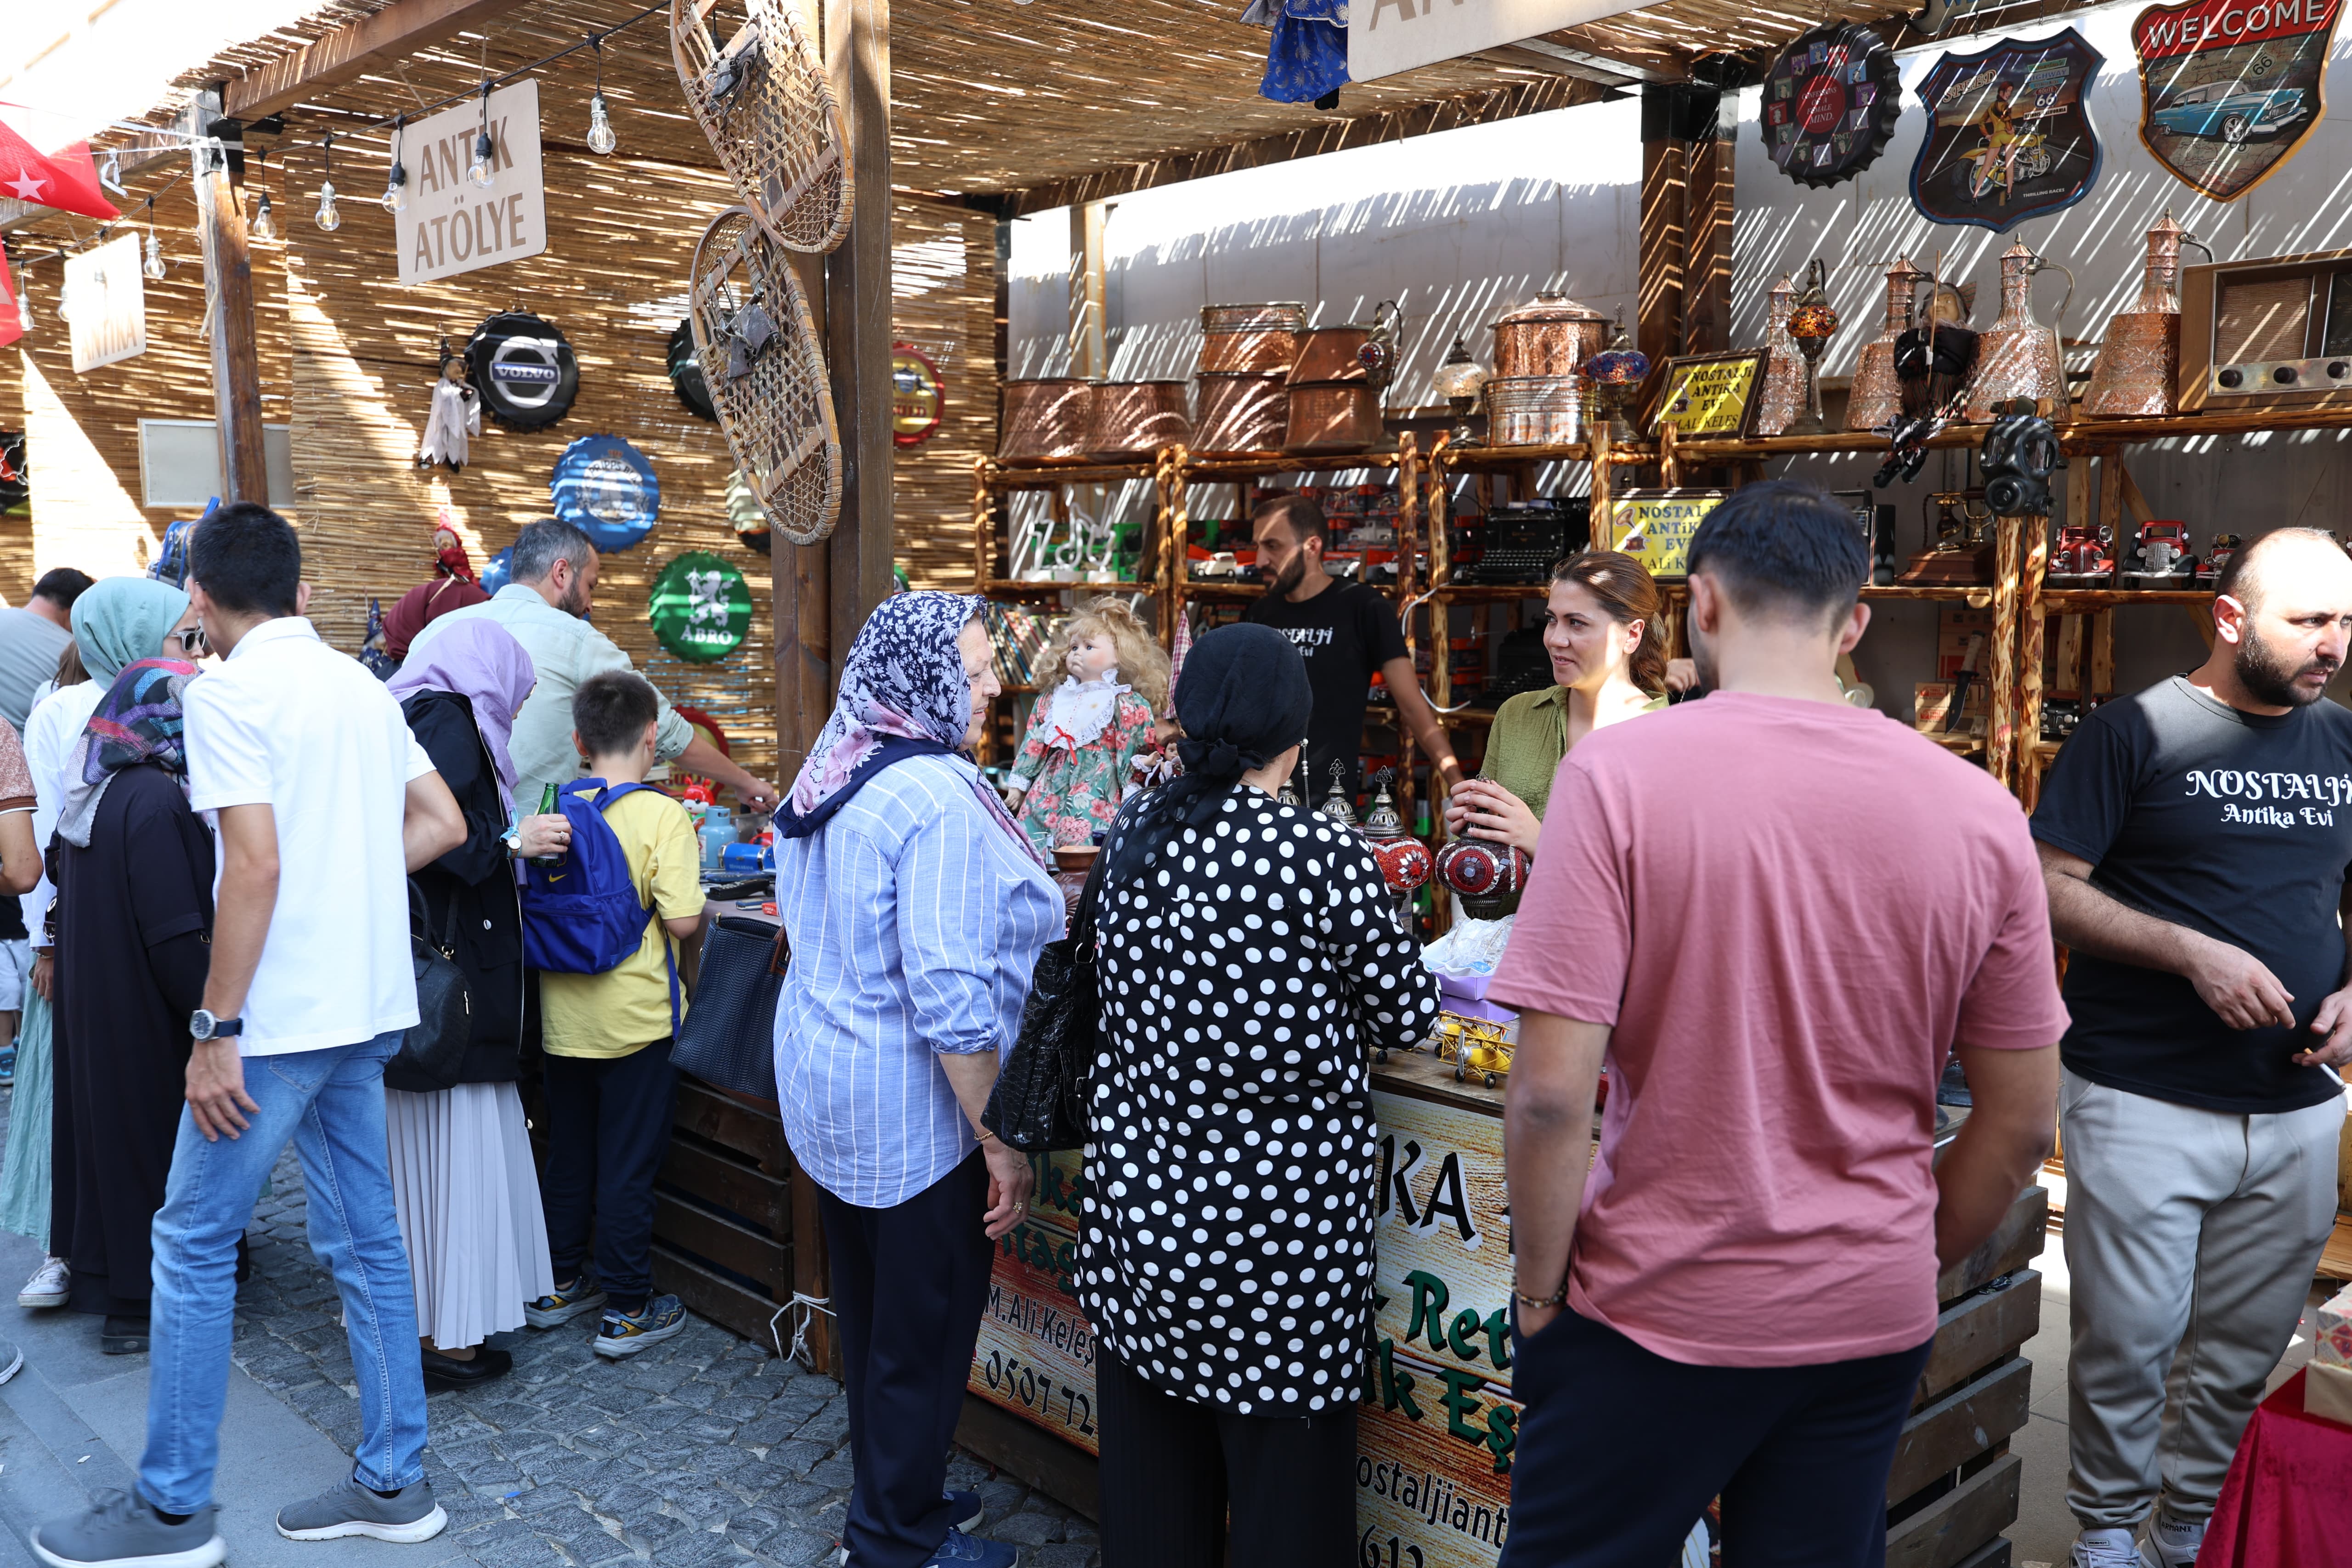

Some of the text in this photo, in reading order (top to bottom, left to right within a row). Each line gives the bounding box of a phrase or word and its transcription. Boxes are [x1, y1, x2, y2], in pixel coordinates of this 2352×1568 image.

[2148, 0, 2325, 48] WELCOME
[2025, 69, 2067, 82] IGHWAY
[2252, 56, 2272, 75] 66
[1810, 112, 1834, 125] MIND.
[2036, 93, 2055, 107] 66
[415, 194, 526, 273] ATÖLYE
[494, 366, 555, 379] VOLVO
[893, 404, 927, 417] ULD
[2221, 803, 2334, 829] Antika Evi
[1378, 1134, 1482, 1251] KA
[985, 1283, 1037, 1335] M.Ali
[1040, 1306, 1097, 1369] Keleş
[1402, 1269, 1511, 1371] Ret
[985, 1349, 1052, 1416] 0507
[1061, 1385, 1096, 1438] 72
[1434, 1368, 1517, 1474] Eş
[1356, 1455, 1509, 1550] ostaljiant
[2161, 1521, 2192, 1533] ARMANI
